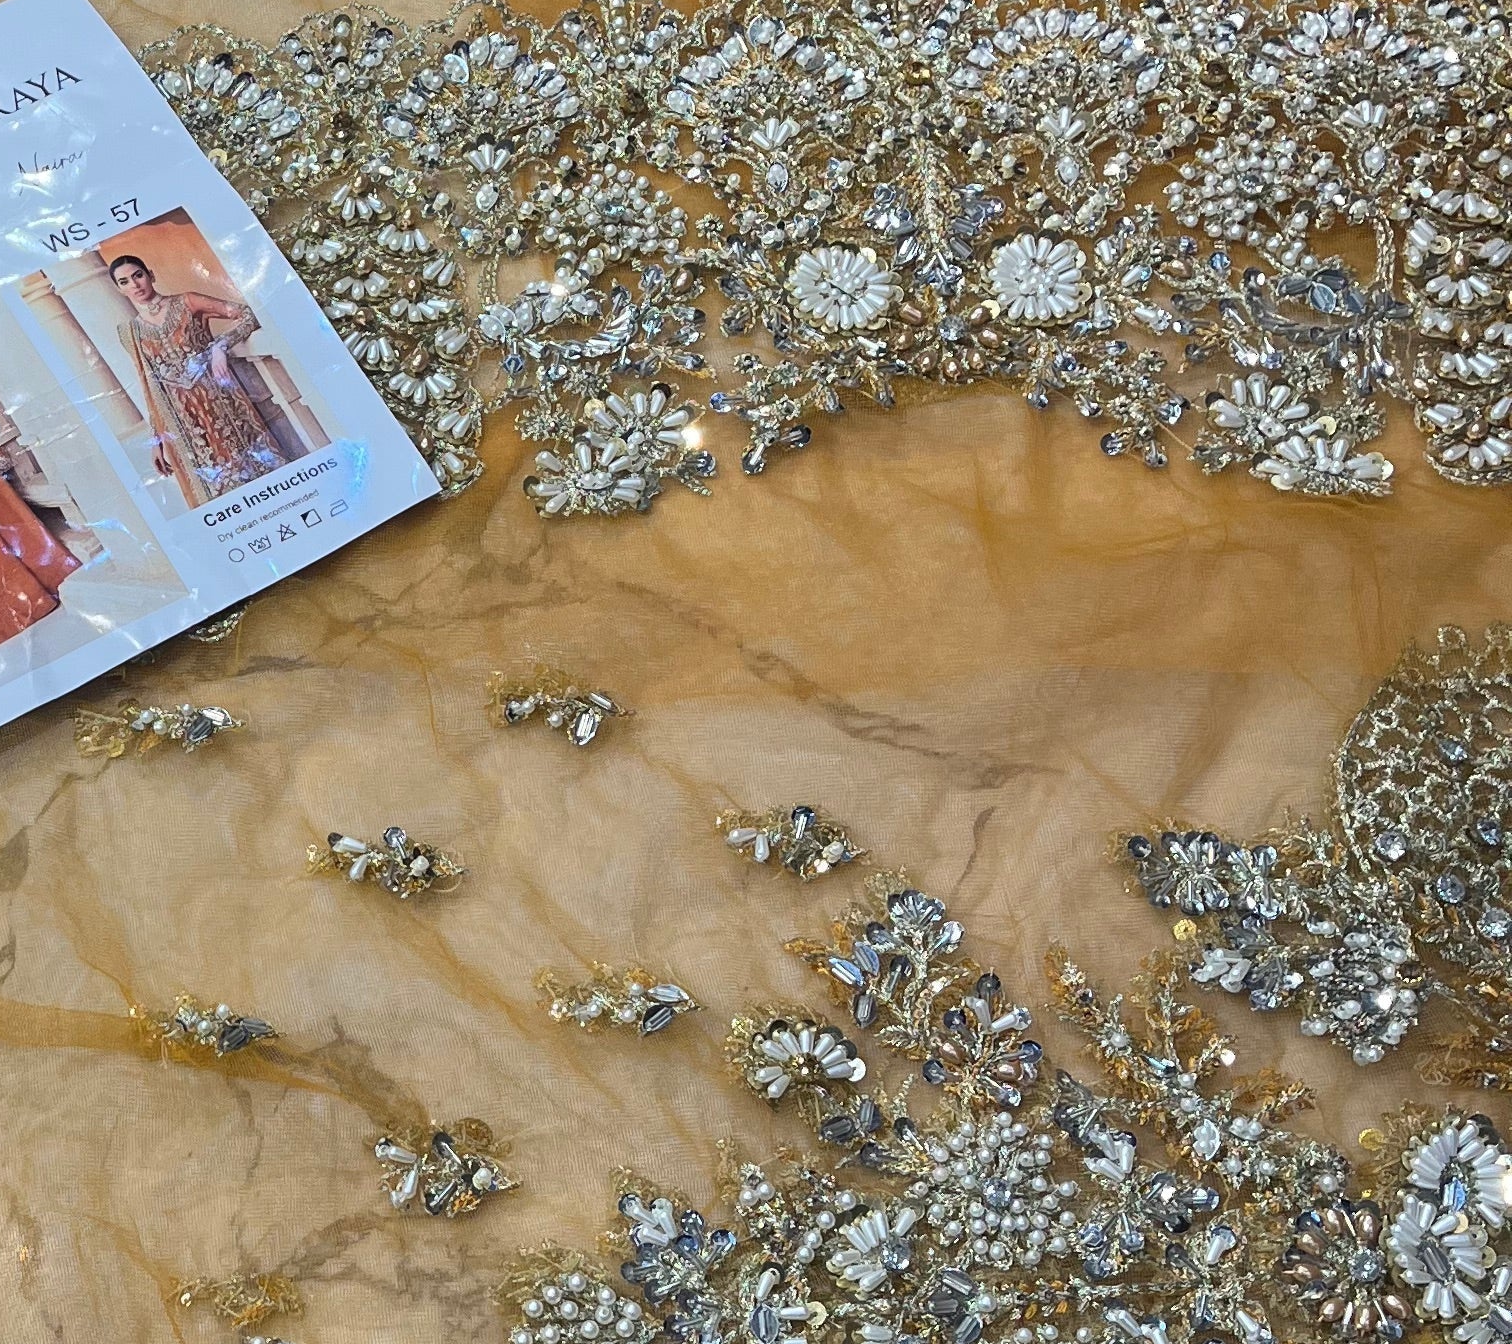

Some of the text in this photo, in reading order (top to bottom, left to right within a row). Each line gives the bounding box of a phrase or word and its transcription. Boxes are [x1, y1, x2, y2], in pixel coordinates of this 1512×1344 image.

[41, 222, 91, 254] WS
[109, 198, 141, 223] 57
[203, 457, 338, 527] Care Instructions
[217, 488, 320, 543] Dry clean recommended
